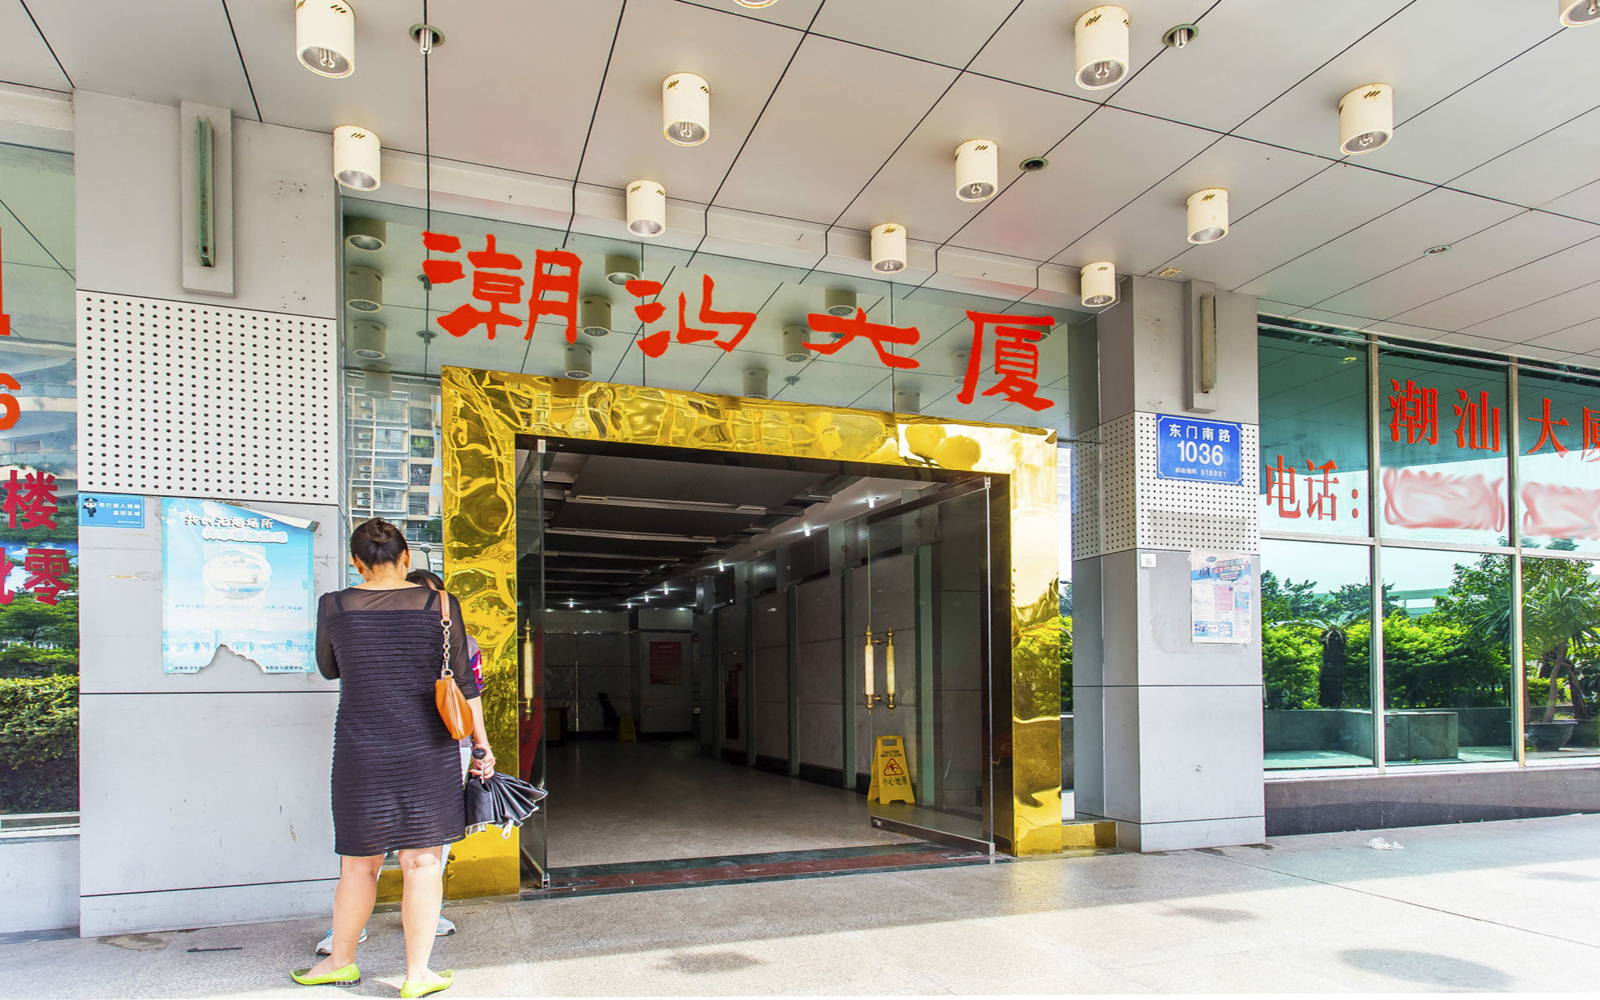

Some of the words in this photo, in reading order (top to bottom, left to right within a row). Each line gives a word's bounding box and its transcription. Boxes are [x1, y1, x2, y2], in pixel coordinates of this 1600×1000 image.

[423, 231, 1055, 411] 潮汕大厦
[1169, 423, 1231, 443] 东门南路
[1177, 440, 1224, 466] 1036
[1201, 469, 1227, 477] 518001
[883, 776, 907, 786] 小心地滑
